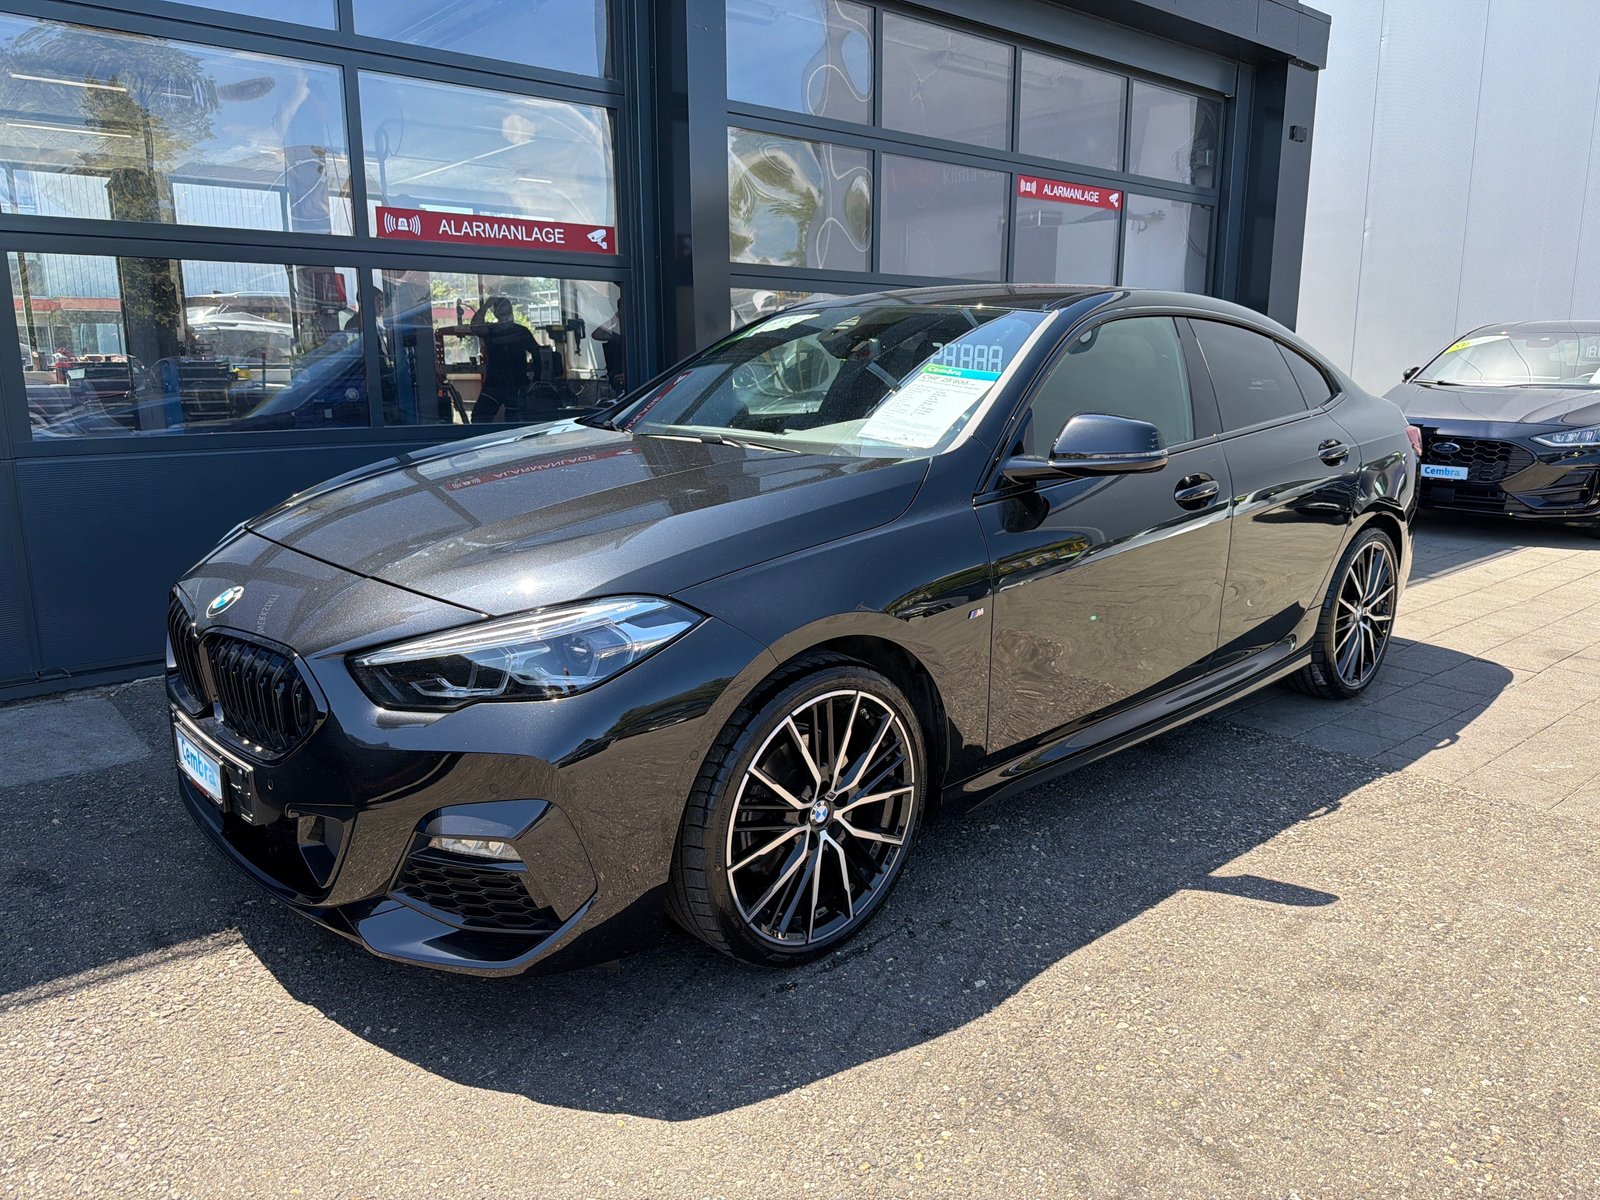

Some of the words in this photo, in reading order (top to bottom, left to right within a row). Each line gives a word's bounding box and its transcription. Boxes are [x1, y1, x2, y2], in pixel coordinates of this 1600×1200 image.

[1042, 184, 1100, 203] ALARMANLAGE
[438, 219, 566, 244] ALARMANLAGE
[922, 374, 941, 382] CHF
[1424, 466, 1461, 477] Cembra
[180, 737, 217, 787] Cembra
